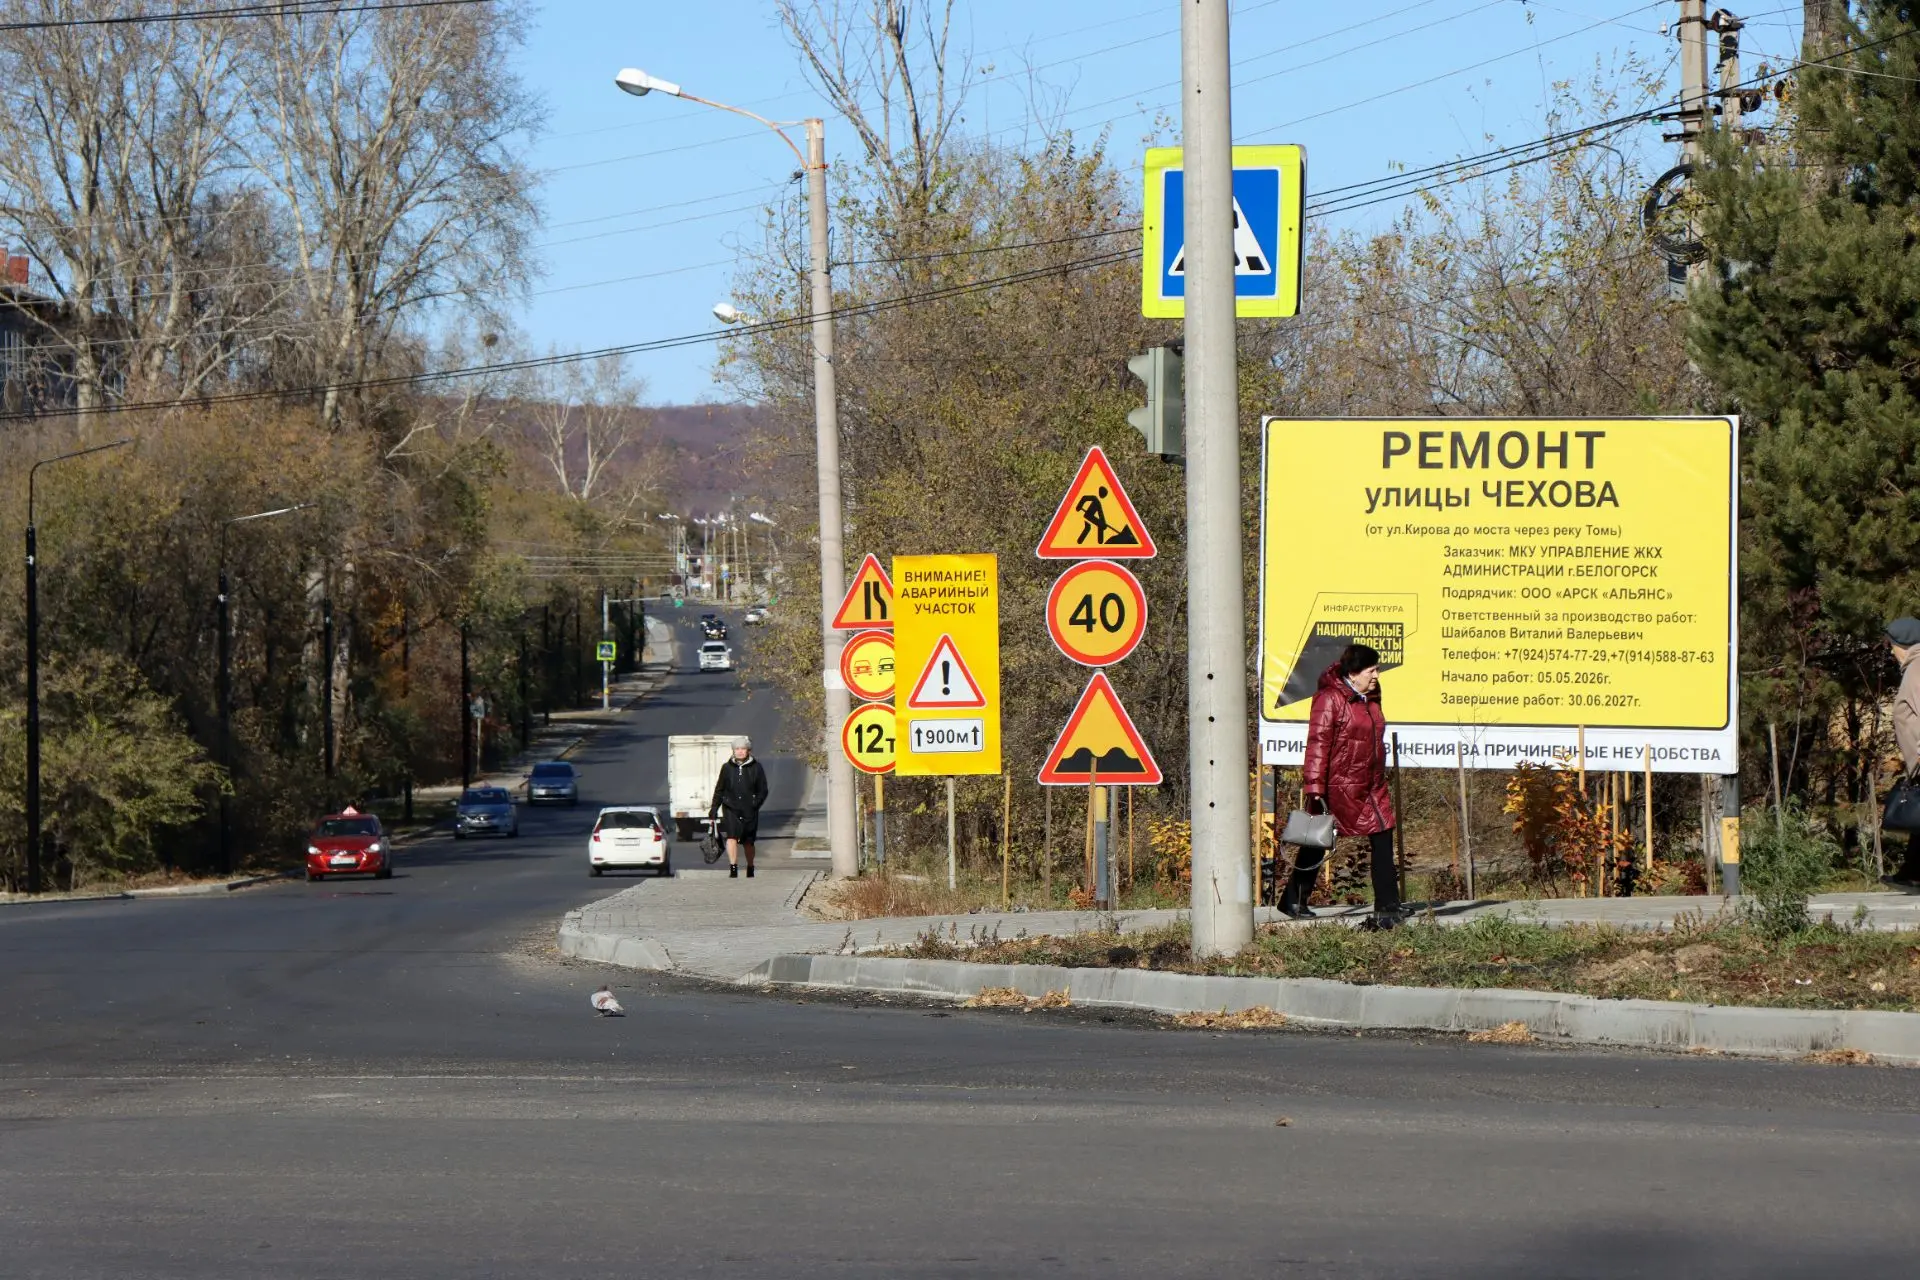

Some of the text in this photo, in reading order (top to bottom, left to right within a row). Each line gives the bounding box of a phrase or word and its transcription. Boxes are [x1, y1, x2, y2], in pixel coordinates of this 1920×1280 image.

[1383, 431, 1605, 469] РЕМОНТ
[1365, 480, 1619, 514] улицы ЧЕХОВА
[1366, 524, 1621, 538] (от ул.Кирова до моста через реку Томь)
[1444, 546, 1662, 558] Заказчик: МКУ УПРАВЛЕНИЕ ЖКХ
[905, 570, 985, 582] ВНИМАНИЕ!
[1443, 564, 1657, 578] АДМИНИСТРАЦИИ г.БЕЛОГОРСК
[901, 585, 988, 598] АВАРИЙНЫЙ
[1443, 587, 1672, 600] Подрядчик: ООО «АРСК «АЛЬЯНС»
[915, 603, 975, 614] УЧАСТОК
[1069, 593, 1125, 633] 40
[1442, 609, 1696, 625] Ответственный за производство работ:
[1316, 623, 1402, 637] НАЦИОНАЛЬНЫЕ
[1442, 627, 1642, 642] Шайбалов Виталий Валерьевич
[1378, 651, 1402, 664] СИИ
[1442, 648, 1499, 662] Телефон:
[1442, 671, 1611, 685] Начало работ: 05.05.2026г.
[1441, 693, 1640, 708] Завершение работ: 30.06.2027г.
[926, 729, 968, 744] 900м
[1266, 740, 1306, 752] ПРИН
[1385, 742, 1455, 755] ВИНЕНИЯ
[1462, 744, 1480, 756] ЗА
[1613, 746, 1721, 763] НЕУДОБСТВА
